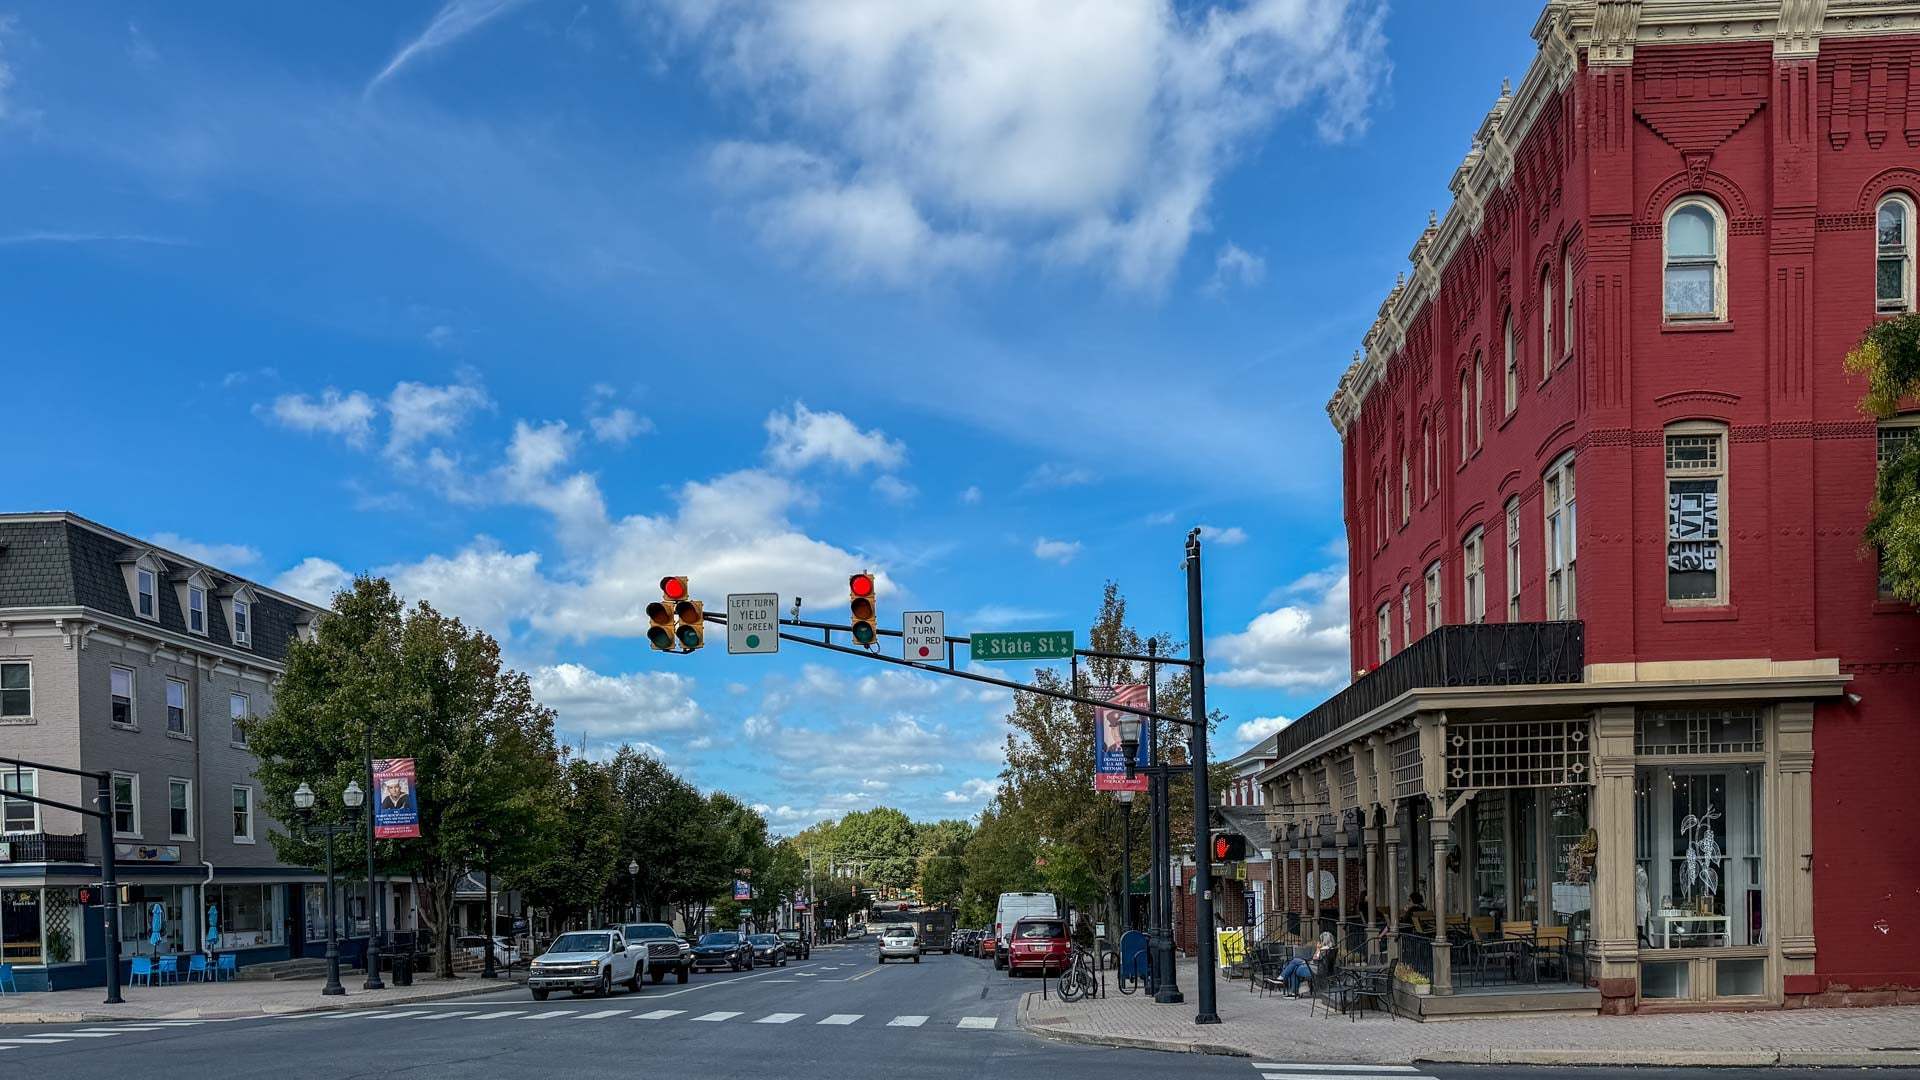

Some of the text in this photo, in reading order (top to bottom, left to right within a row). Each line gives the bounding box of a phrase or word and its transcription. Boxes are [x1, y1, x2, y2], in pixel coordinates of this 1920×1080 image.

[731, 599, 774, 608] LEFT TURN
[740, 610, 767, 620] YIELD
[914, 614, 932, 624] NO
[733, 622, 773, 631] ON GREEN
[912, 626, 936, 634] TURN
[906, 636, 940, 645] ON RED
[991, 639, 1031, 654] State
[1038, 637, 1055, 653] St
